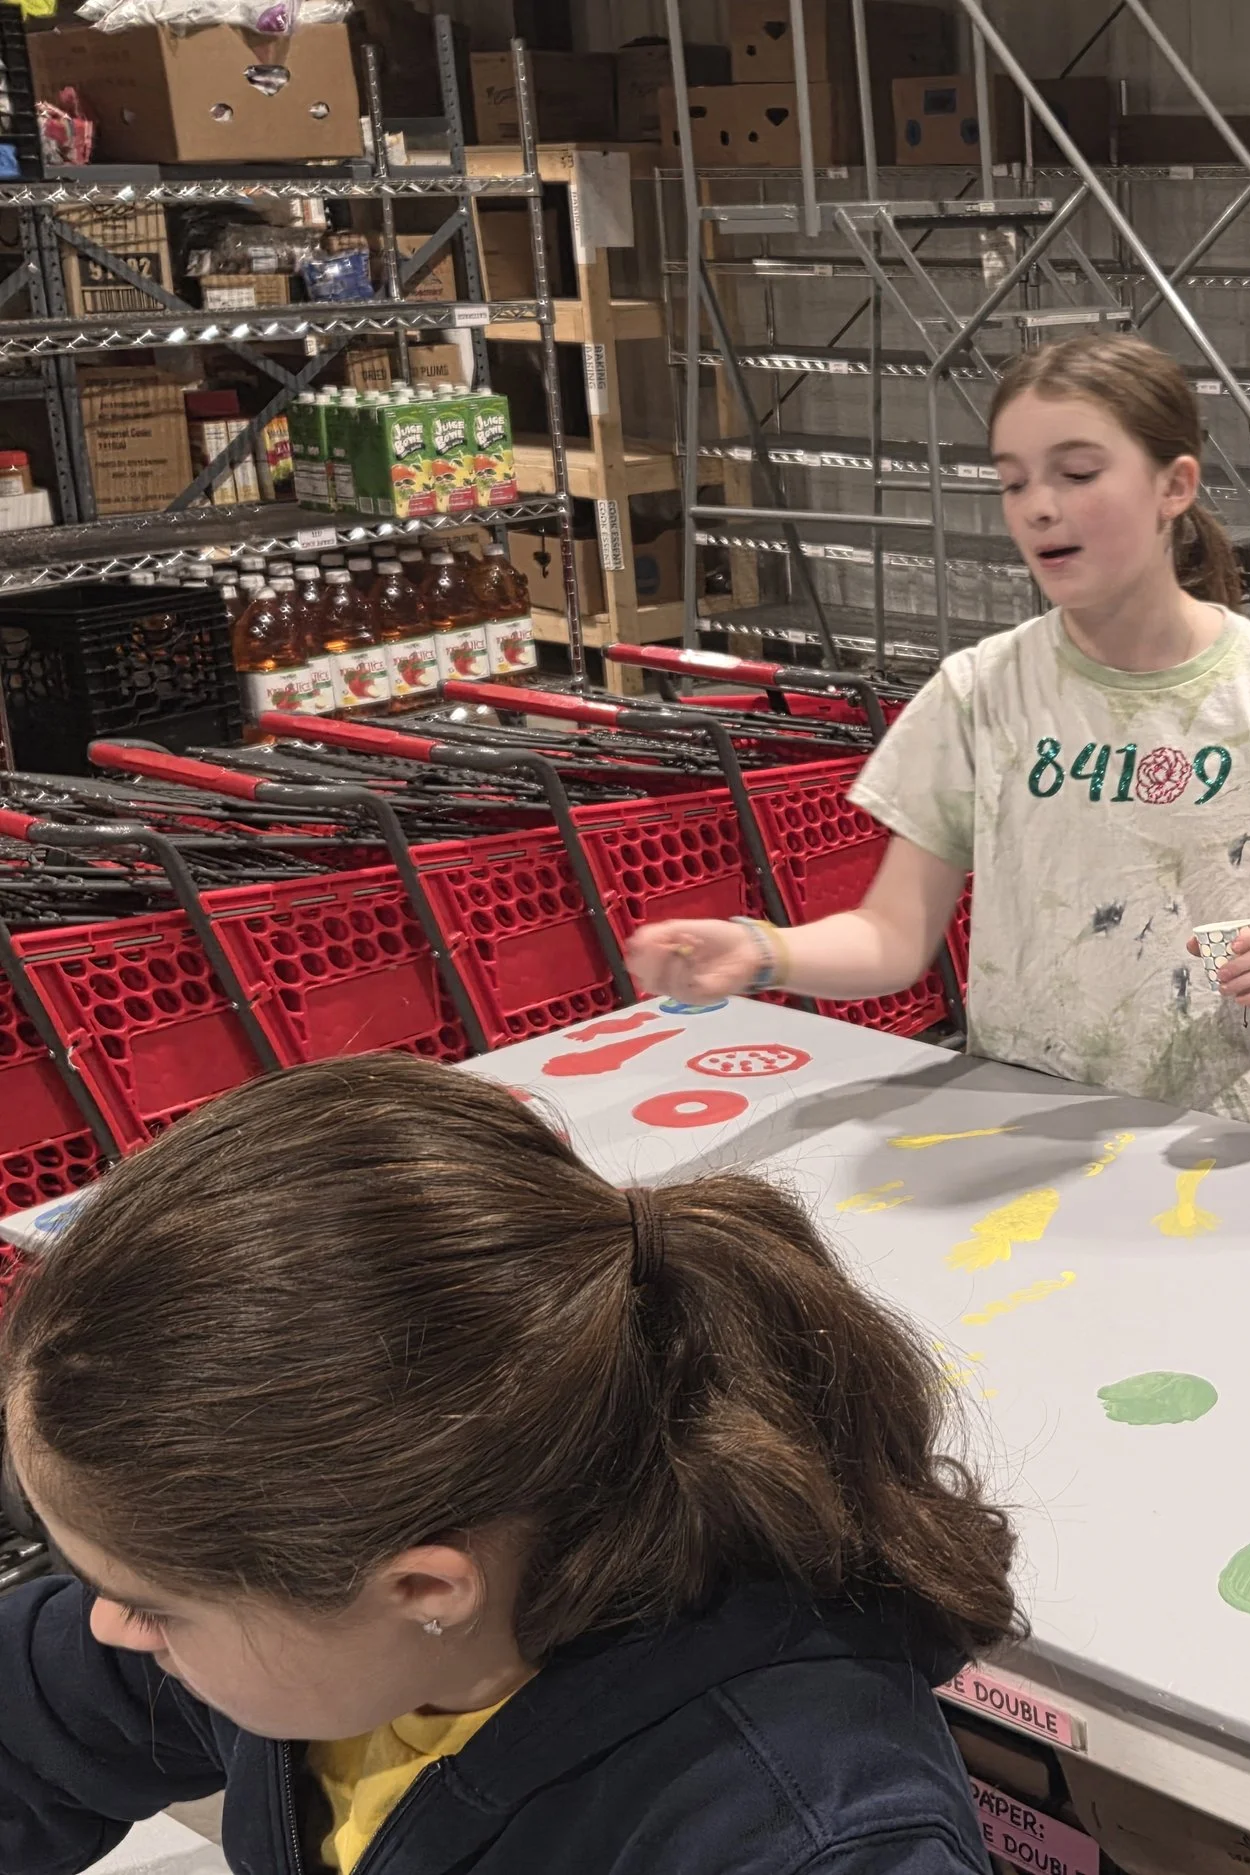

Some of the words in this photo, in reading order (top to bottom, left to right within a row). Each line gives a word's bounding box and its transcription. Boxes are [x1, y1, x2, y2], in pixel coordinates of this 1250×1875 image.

[594, 345, 607, 390] BAKING
[608, 501, 618, 529] COOK
[973, 1681, 1058, 1734] DOUBLE
